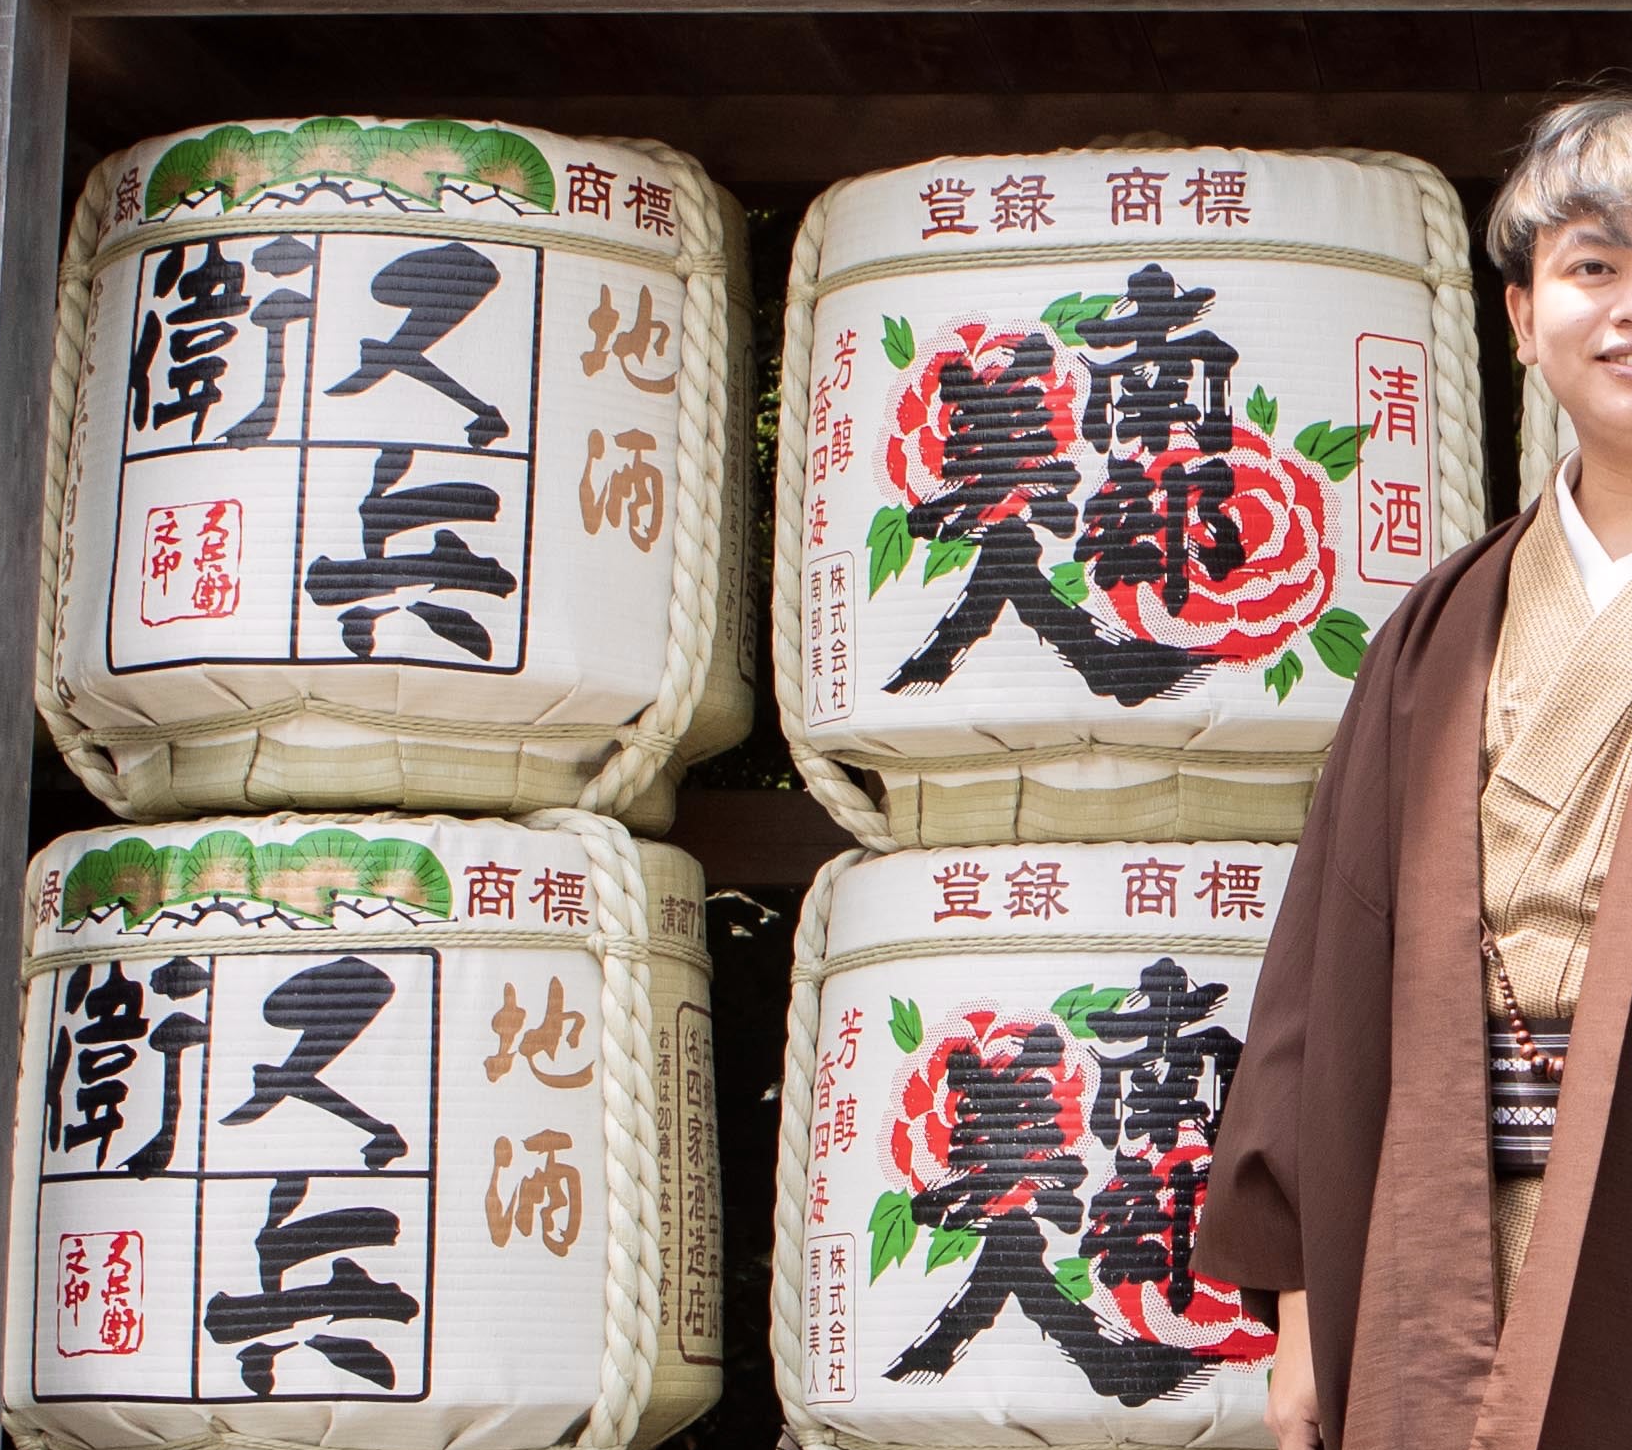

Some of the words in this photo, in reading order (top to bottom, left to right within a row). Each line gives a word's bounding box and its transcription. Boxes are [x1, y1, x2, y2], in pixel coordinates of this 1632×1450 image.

[566, 162, 676, 236] 商標
[920, 173, 1056, 239] 登録
[1106, 166, 1251, 227] 商標
[580, 284, 677, 552] 地酒
[1369, 364, 1422, 558] 清酒
[464, 862, 592, 926] 商標
[932, 861, 1070, 922] 登録
[1121, 858, 1266, 920] 商標
[482, 977, 596, 1258] 地酒
